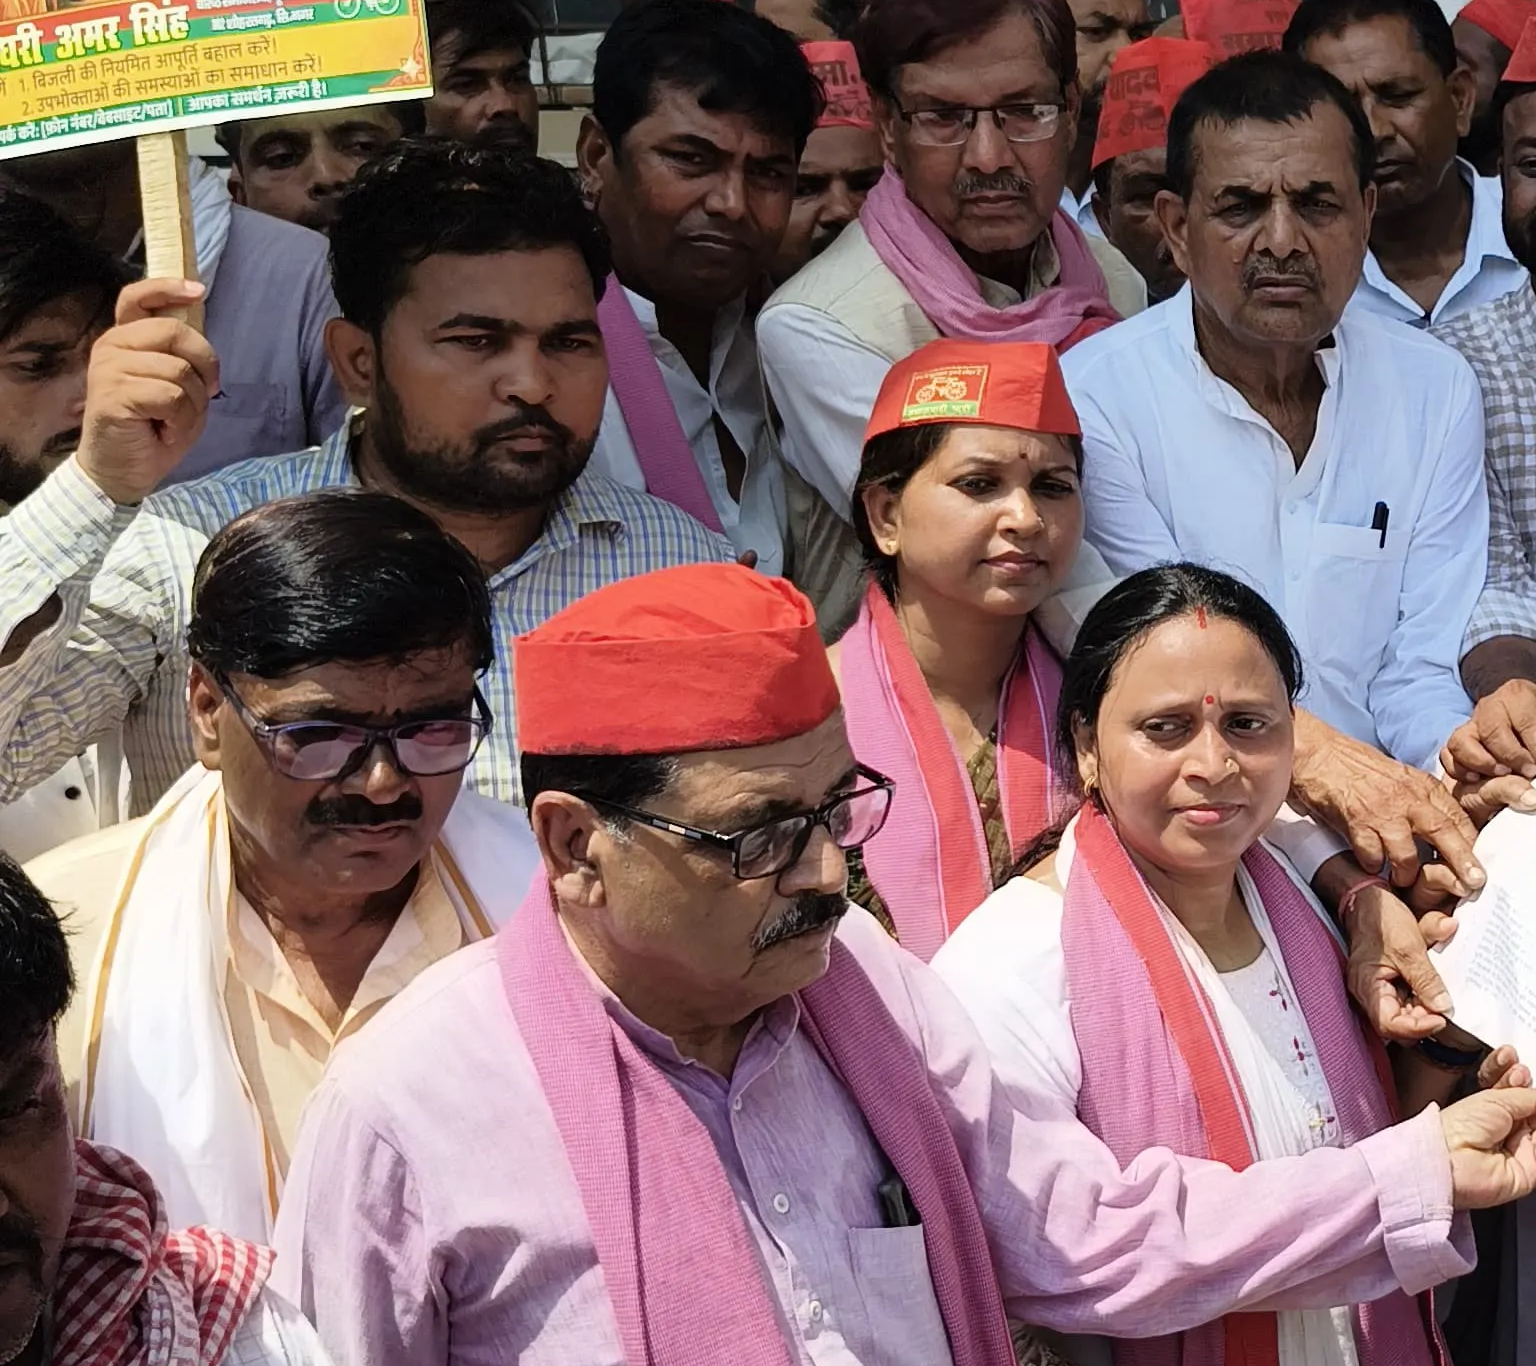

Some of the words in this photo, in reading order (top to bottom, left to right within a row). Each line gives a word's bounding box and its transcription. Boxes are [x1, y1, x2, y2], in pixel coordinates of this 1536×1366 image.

[54, 16, 122, 59] अमर
[19, 78, 30, 92] 1.
[32, 64, 76, 89] बिजली
[79, 60, 97, 80] की
[101, 53, 151, 78] नियमित
[156, 43, 198, 71] आपूर्ति
[203, 43, 243, 62] बहाल
[22, 101, 34, 116] 2.
[36, 81, 109, 112] उपभोक्ताओं
[113, 79, 131, 98] की
[136, 67, 200, 95] समस्याओं
[205, 69, 225, 86] का
[230, 62, 288, 81] समाधान
